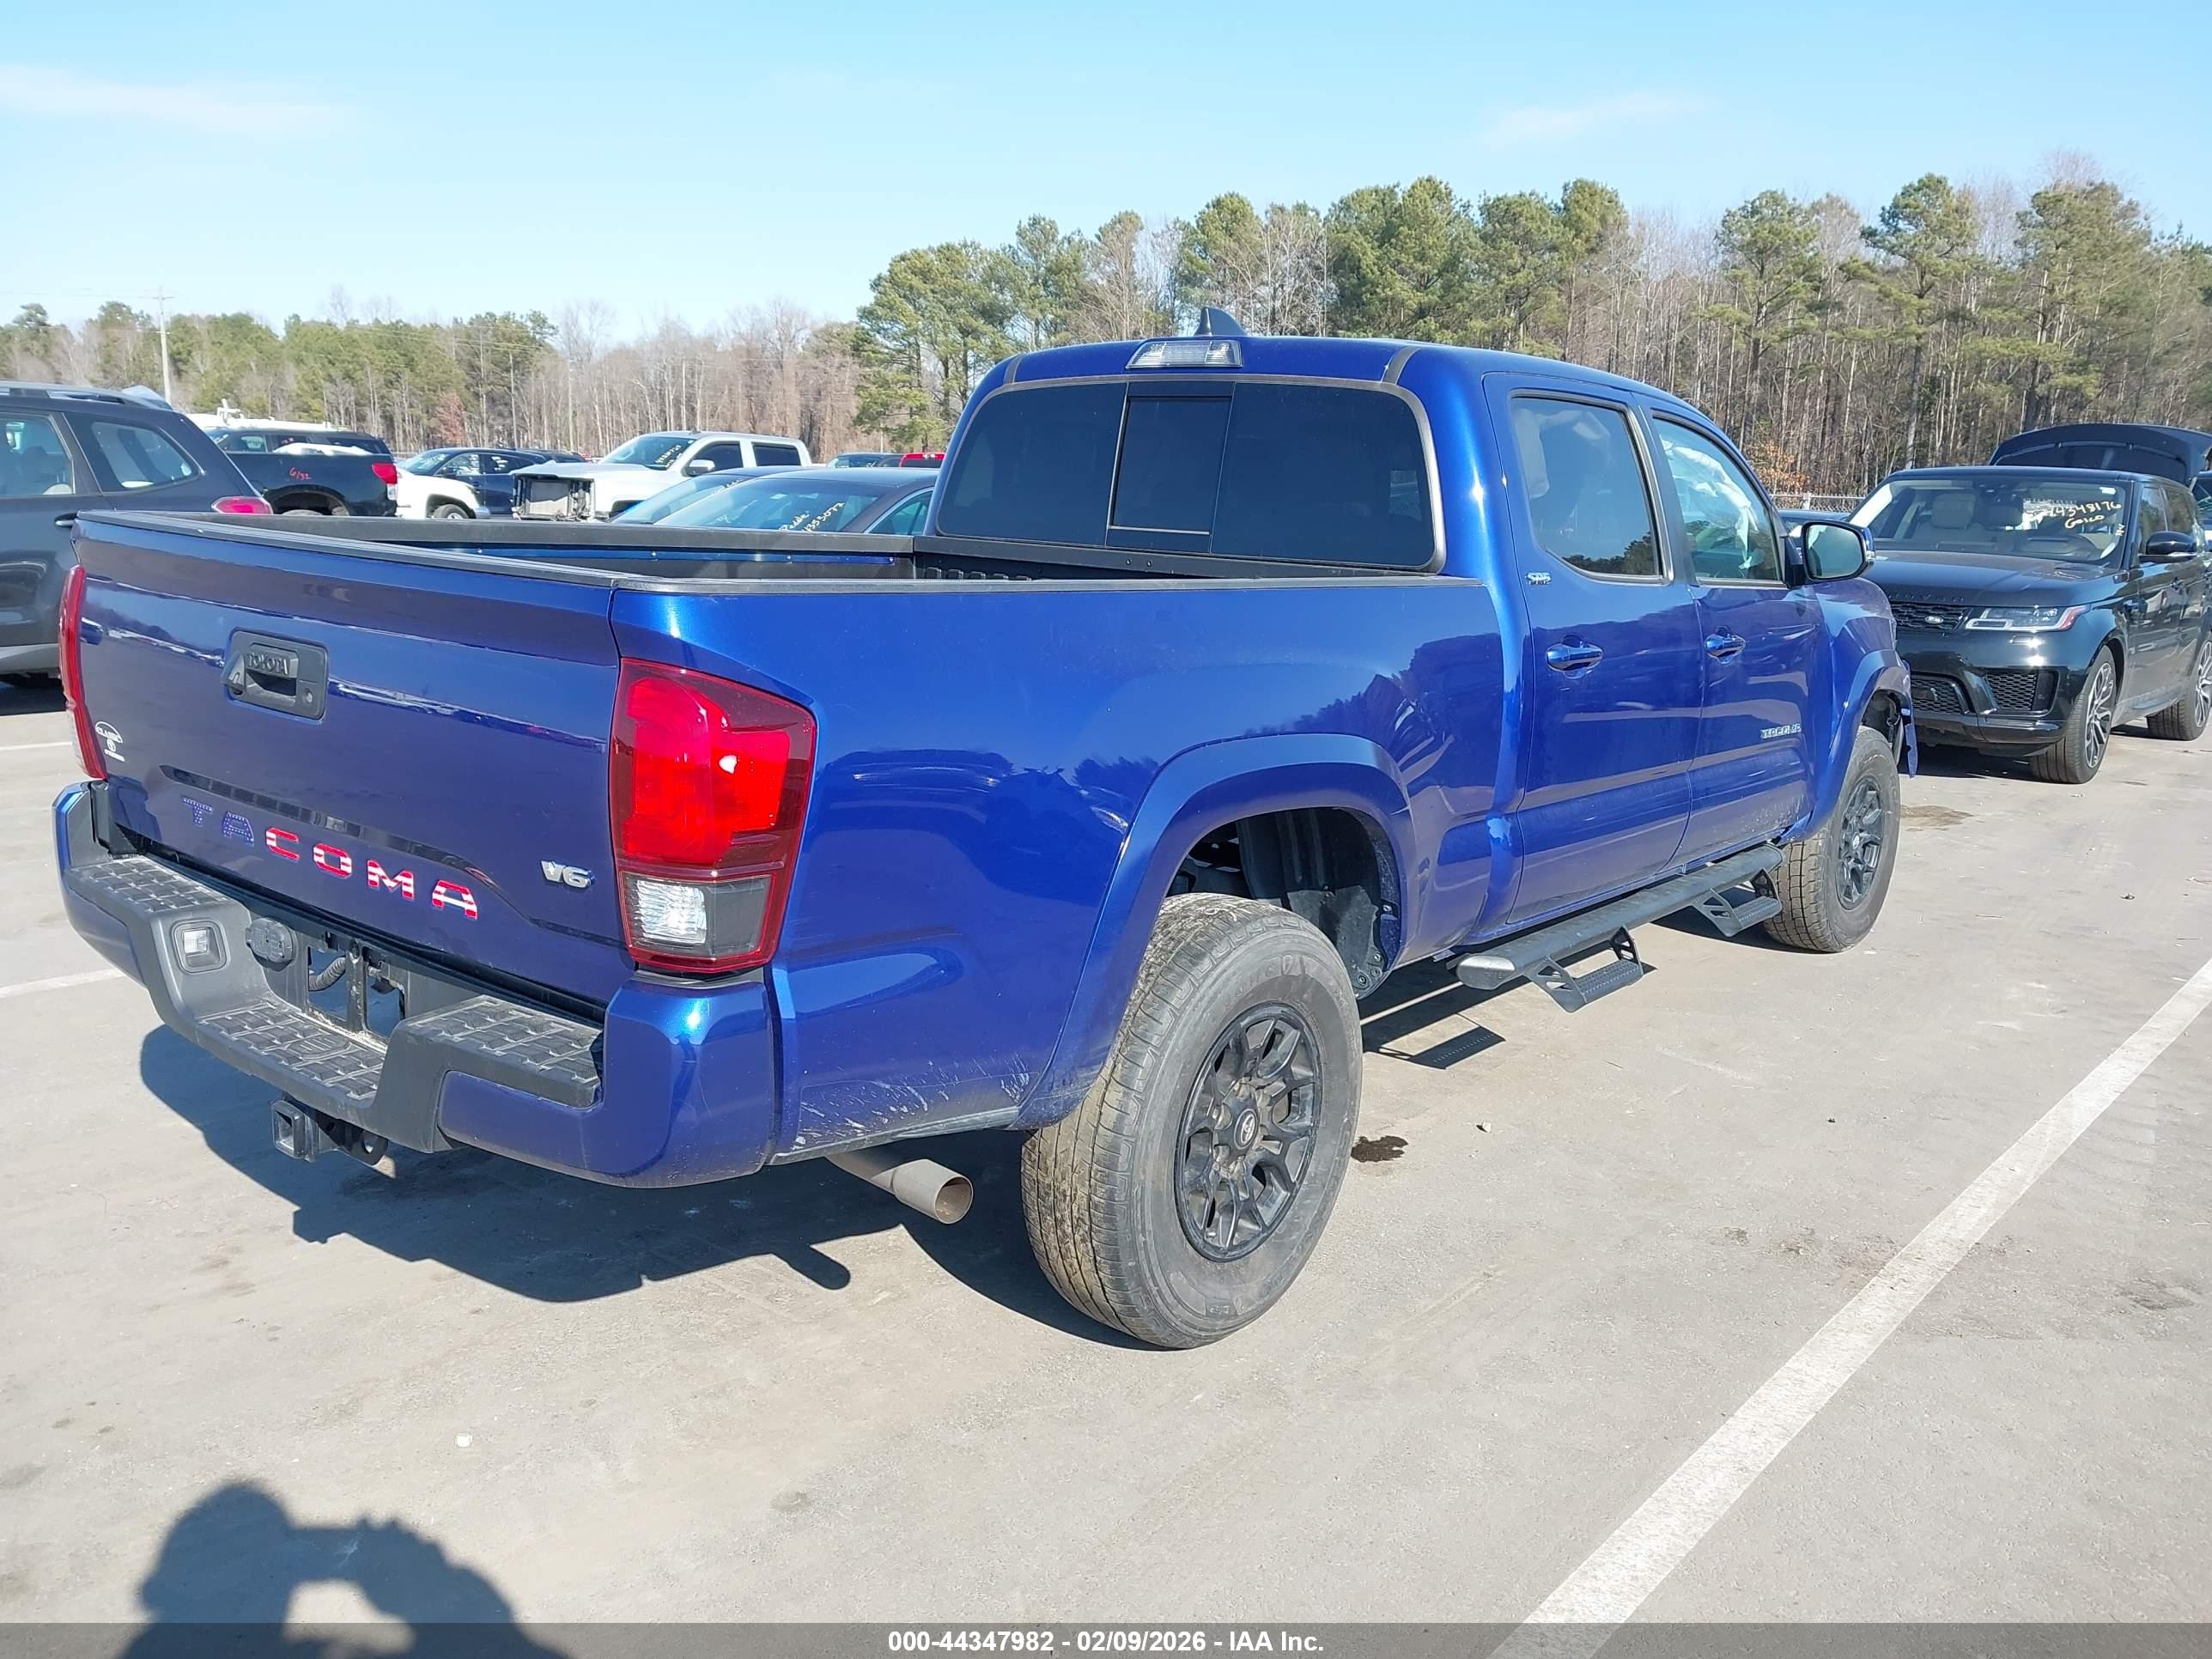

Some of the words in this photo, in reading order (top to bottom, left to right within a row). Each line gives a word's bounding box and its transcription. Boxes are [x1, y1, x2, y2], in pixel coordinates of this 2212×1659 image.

[247, 652, 289, 676] TOYOTA
[181, 795, 479, 921] TACOMA
[540, 859, 597, 890] V6
